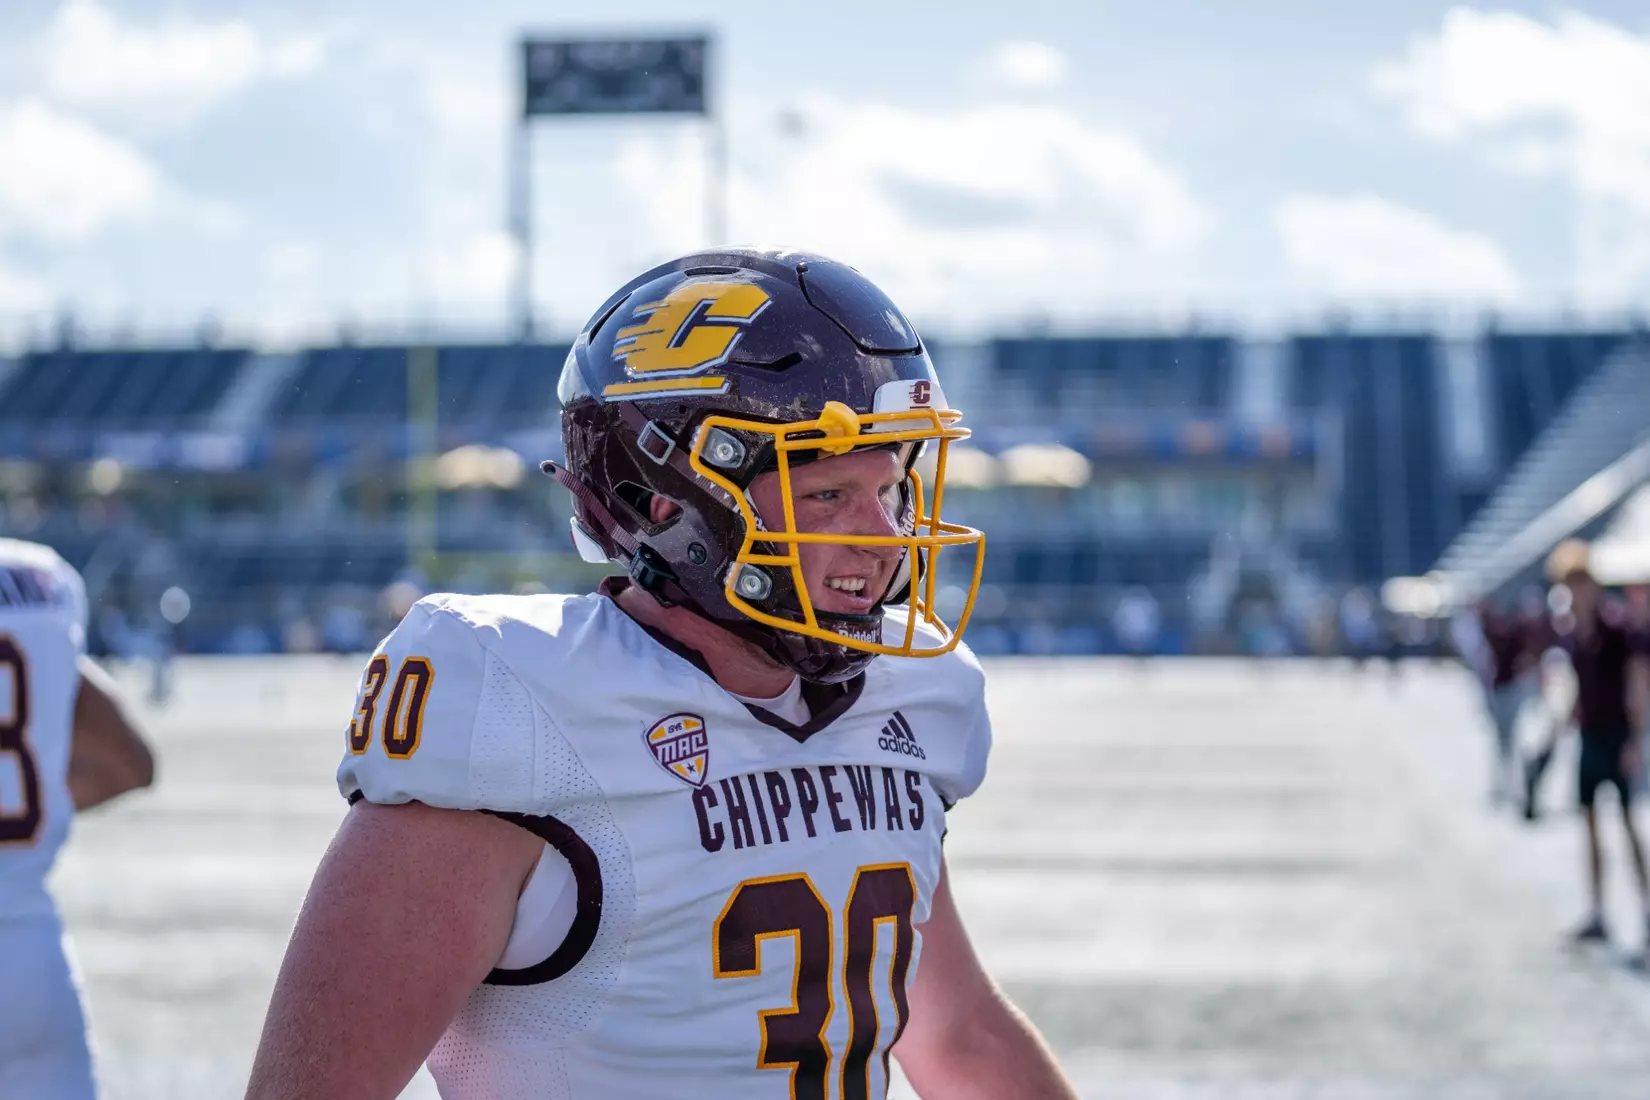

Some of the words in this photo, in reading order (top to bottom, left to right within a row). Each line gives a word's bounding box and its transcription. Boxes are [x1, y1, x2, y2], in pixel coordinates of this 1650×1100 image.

[909, 380, 931, 405] C
[838, 628, 876, 643] Rddell
[350, 654, 435, 760] 30
[655, 732, 708, 763] MAC
[878, 736, 926, 760] adidas
[692, 765, 925, 853] CHIPPEWAS
[712, 862, 917, 1100] 30
